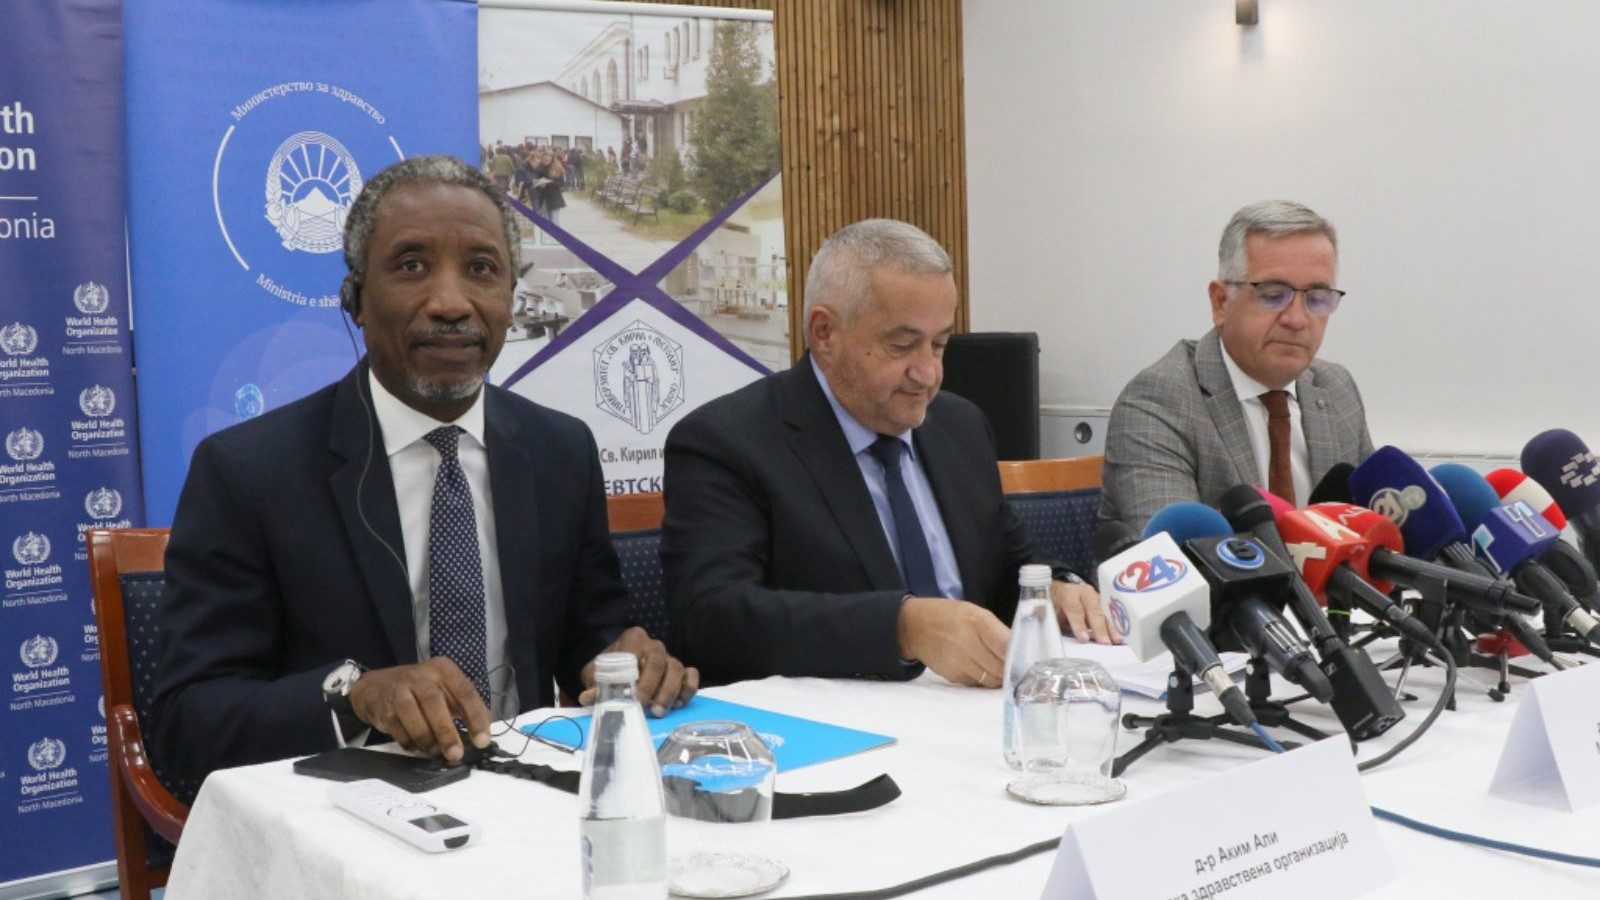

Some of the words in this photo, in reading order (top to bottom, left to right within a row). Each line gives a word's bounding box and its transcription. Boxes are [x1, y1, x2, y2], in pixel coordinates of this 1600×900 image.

[229, 81, 313, 121] Министерство
[316, 82, 329, 93] за
[331, 85, 385, 125] здравство
[256, 273, 306, 306] Ministria
[309, 297, 317, 307] e
[66, 317, 89, 327] World
[93, 316, 117, 326] Health
[66, 326, 117, 337] Organization
[0, 358, 17, 369] orld
[20, 357, 48, 368] Health
[0, 369, 48, 380] rganization
[0, 388, 11, 397] rth
[71, 420, 96, 430] World
[100, 419, 123, 429] Health
[71, 428, 124, 440] Organization
[600, 448, 618, 463] Св.
[620, 447, 657, 464] Кирил
[26, 461, 54, 471] Health
[5, 568, 30, 579] World
[33, 564, 61, 576] Health
[1126, 554, 1177, 592] 24
[6, 575, 61, 589] Organization
[12, 671, 38, 682] World
[41, 667, 68, 678] Health
[13, 677, 69, 691] Organization
[20, 773, 45, 785] World
[49, 768, 76, 780] Health
[21, 778, 76, 794] Organization
[1194, 855, 1216, 875] д-р
[1218, 841, 1251, 864] Аким
[1254, 830, 1279, 850] Али
[1191, 860, 1273, 900] здравствена
[1273, 830, 1349, 872] организација
